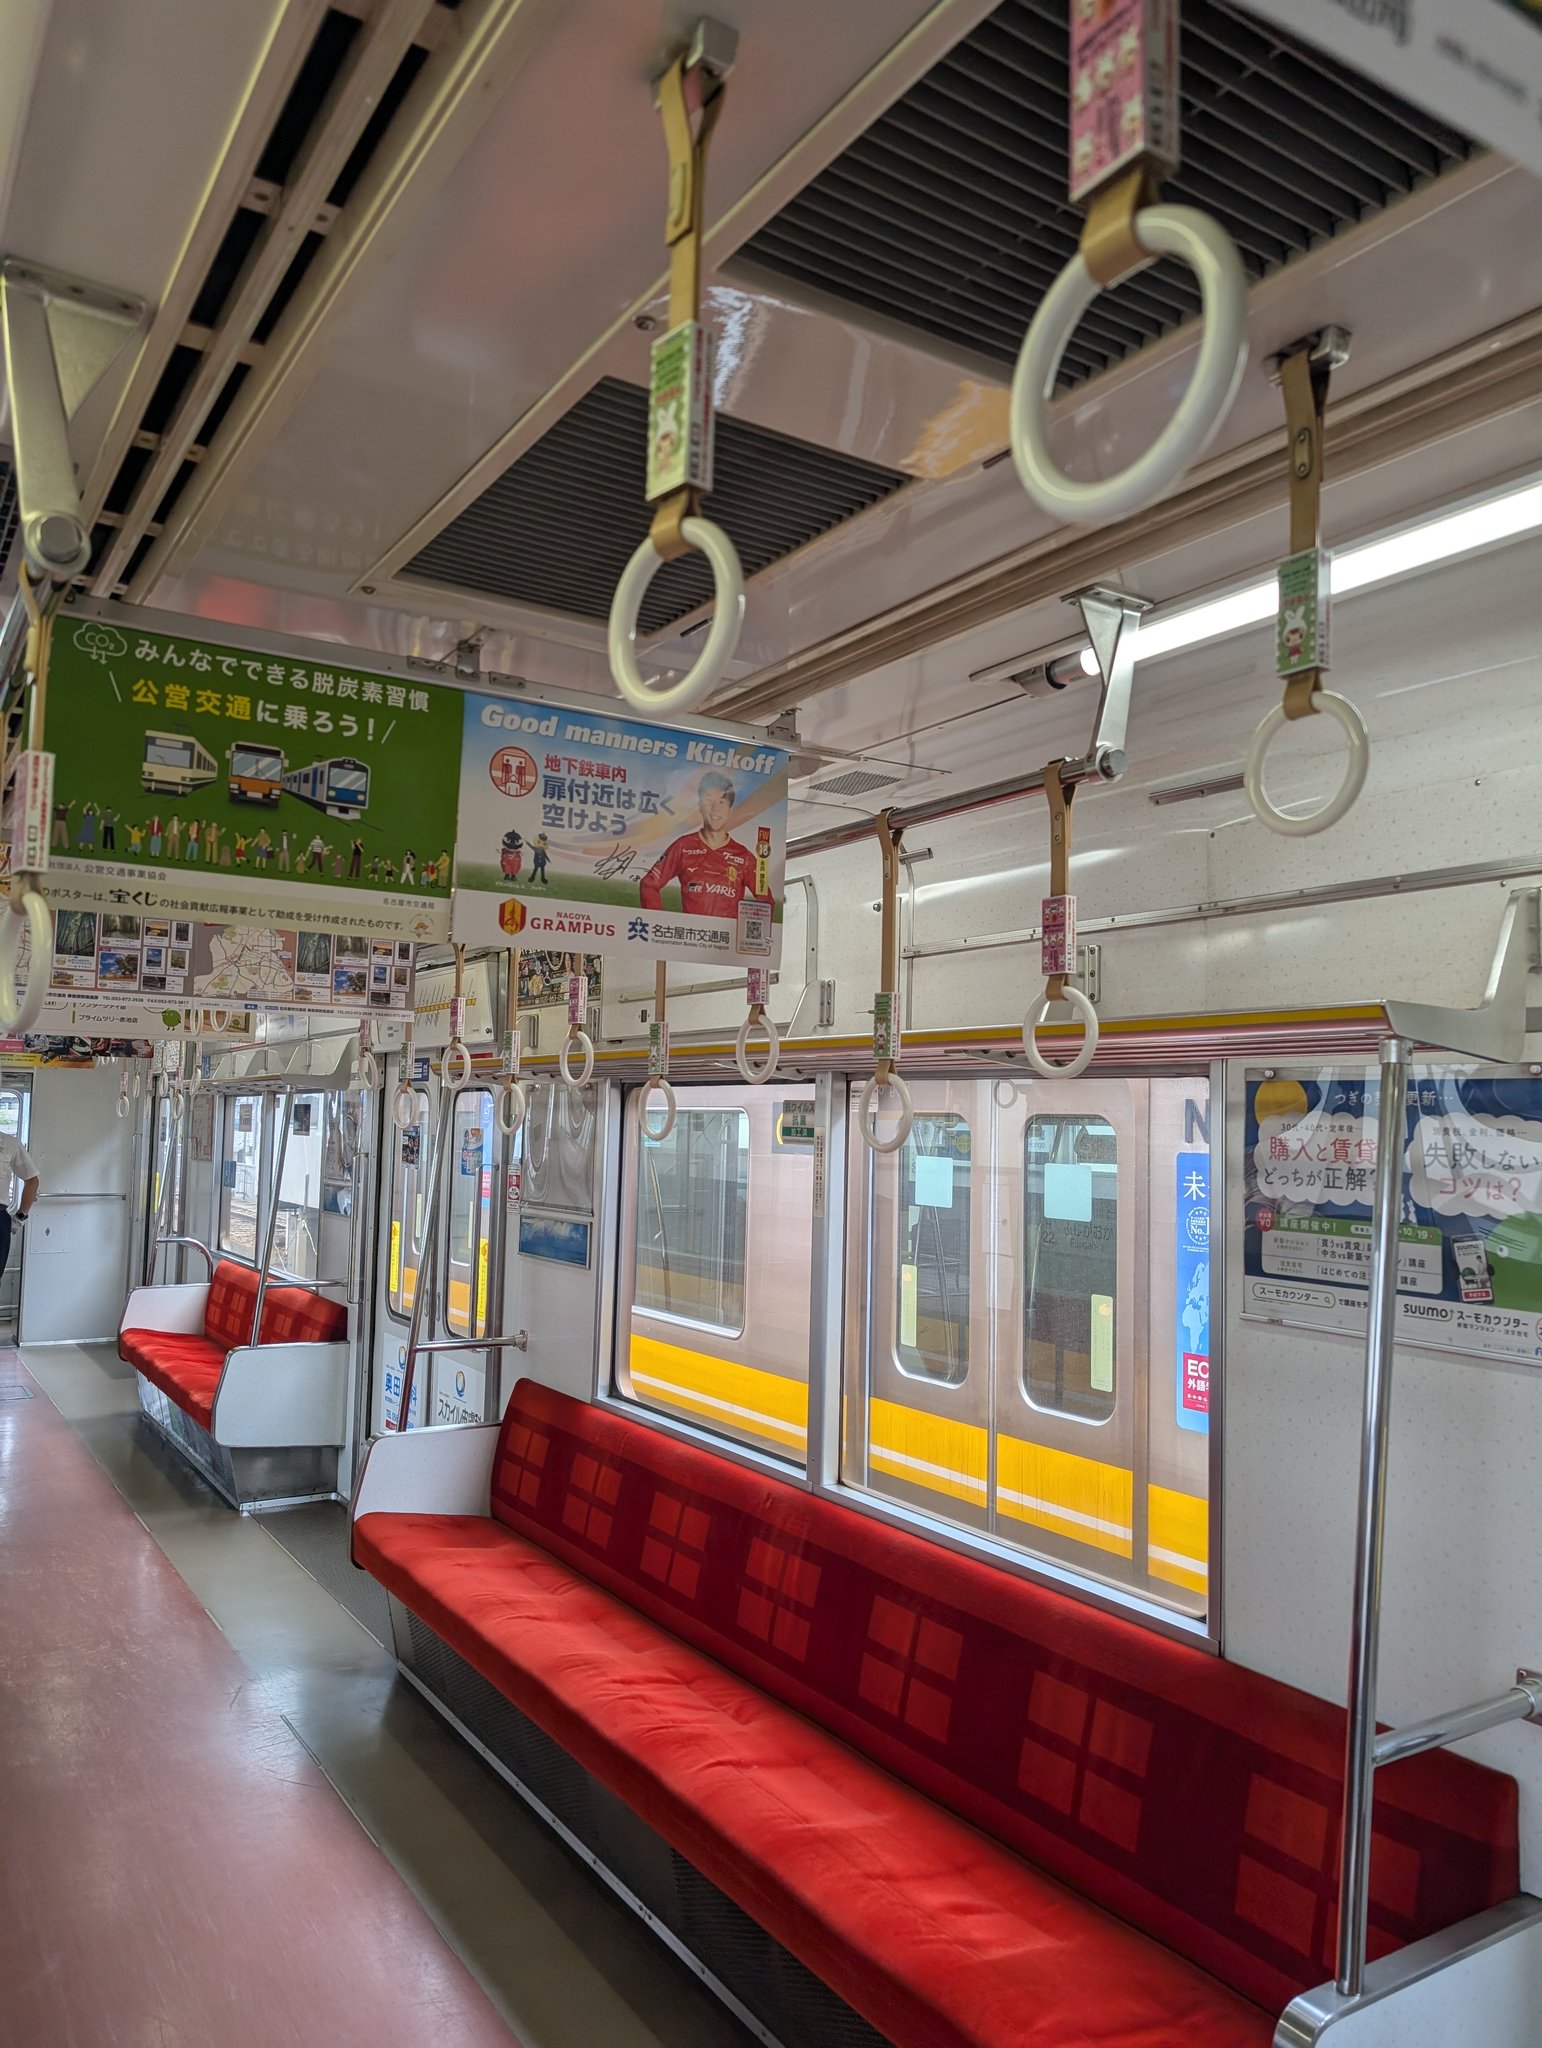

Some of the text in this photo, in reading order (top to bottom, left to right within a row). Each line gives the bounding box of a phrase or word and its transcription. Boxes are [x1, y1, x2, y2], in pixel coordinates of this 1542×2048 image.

[135, 638, 430, 713] みんなでできる脱炭素習慣
[131, 677, 376, 742] 公営交通に乗ろう！
[481, 704, 776, 776] Good manners Kickoff
[544, 754, 627, 784] 地下鉄車内
[542, 774, 676, 817] 扉付近は広く
[541, 803, 628, 836] 空けよう
[758, 845, 769, 856] 18
[84, 864, 167, 881] 公営交通事業協会
[384, 897, 435, 911] 名古屋市交通局
[556, 911, 591, 921] NAGOYA
[530, 917, 616, 937] GRAMPUS
[651, 924, 730, 945] 名古屋市交通局
[1424, 1142, 1539, 1170] 失敗しない
[1439, 1177, 1522, 1202] コツは？
[1259, 1219, 1271, 1228] ¥0
[1279, 1217, 1337, 1233] 講座開催中！
[1259, 1286, 1319, 1302] スーモカウンター
[1403, 1303, 1528, 1328] suumo スーモカウンター
[1187, 1358, 1209, 1378] EC
[1187, 1378, 1209, 1391] 外語
